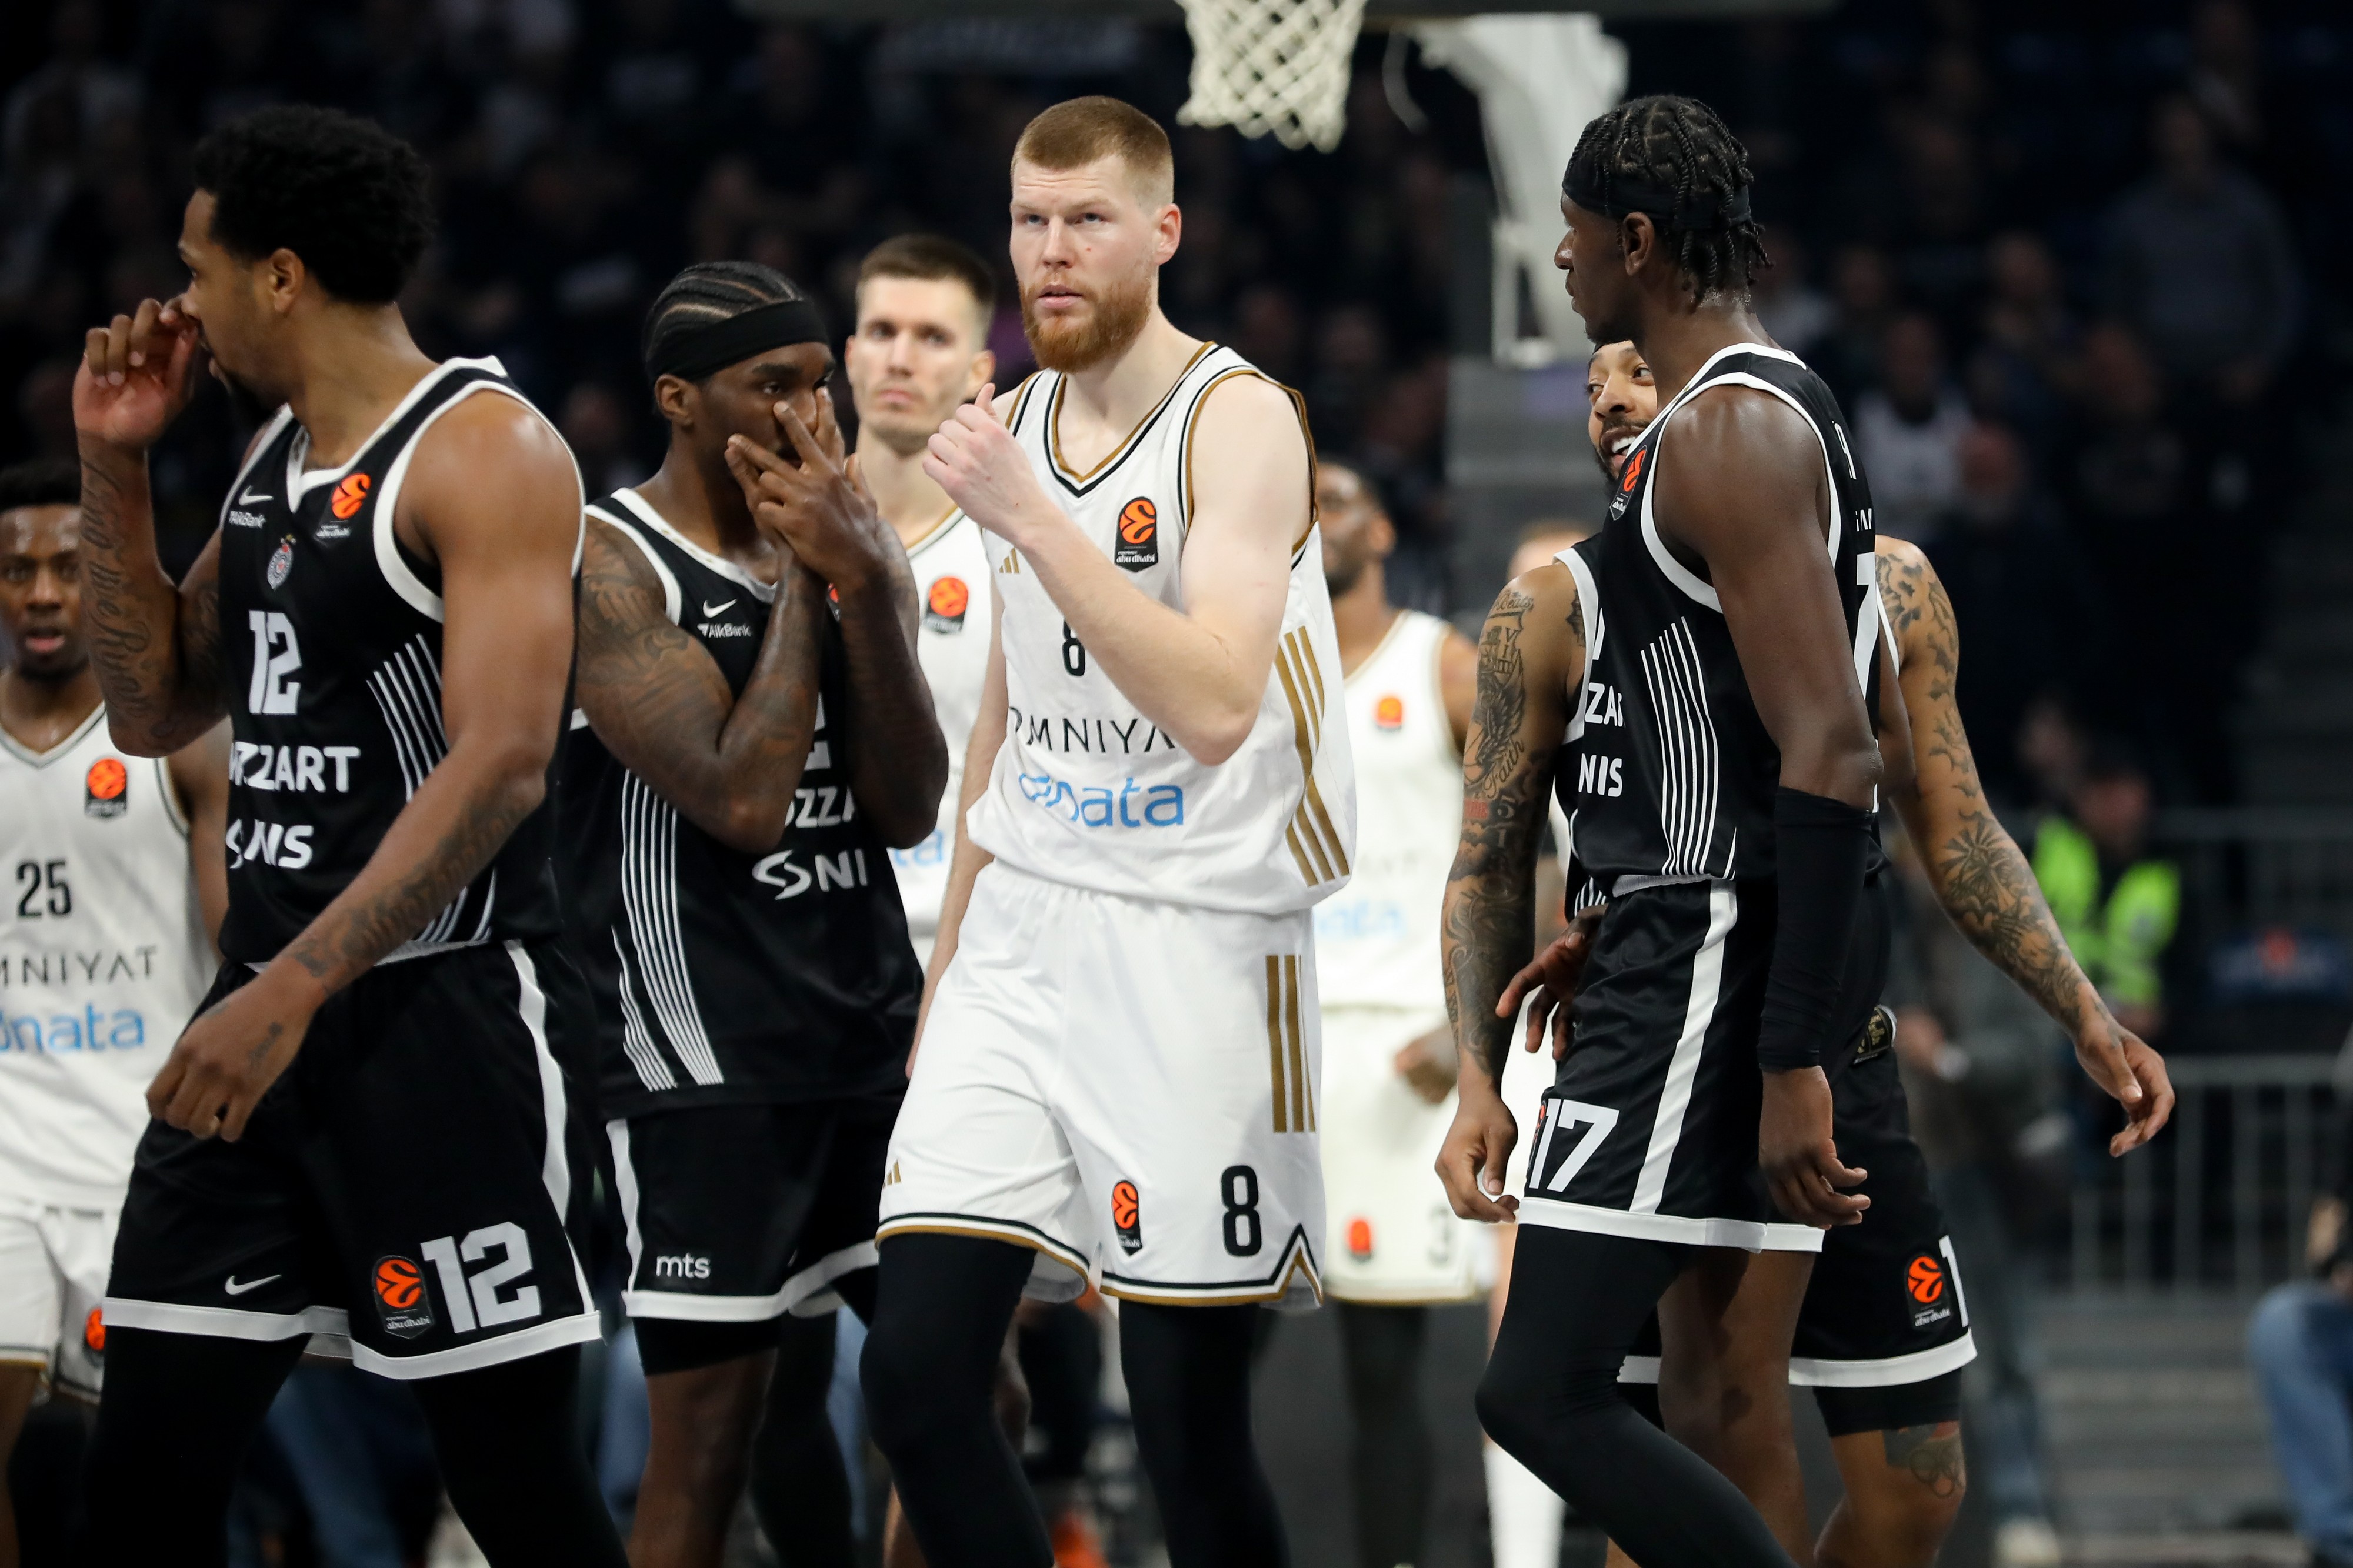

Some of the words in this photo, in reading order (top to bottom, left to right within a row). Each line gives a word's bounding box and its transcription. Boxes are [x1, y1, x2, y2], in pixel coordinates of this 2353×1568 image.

[249, 610, 302, 714] 12
[1578, 753, 1622, 798] NIS
[16, 860, 72, 918] 25
[1529, 1098, 1619, 1192] 17
[1220, 1165, 1262, 1257] 8
[421, 1222, 541, 1333] 12
[655, 1253, 711, 1279] mts
